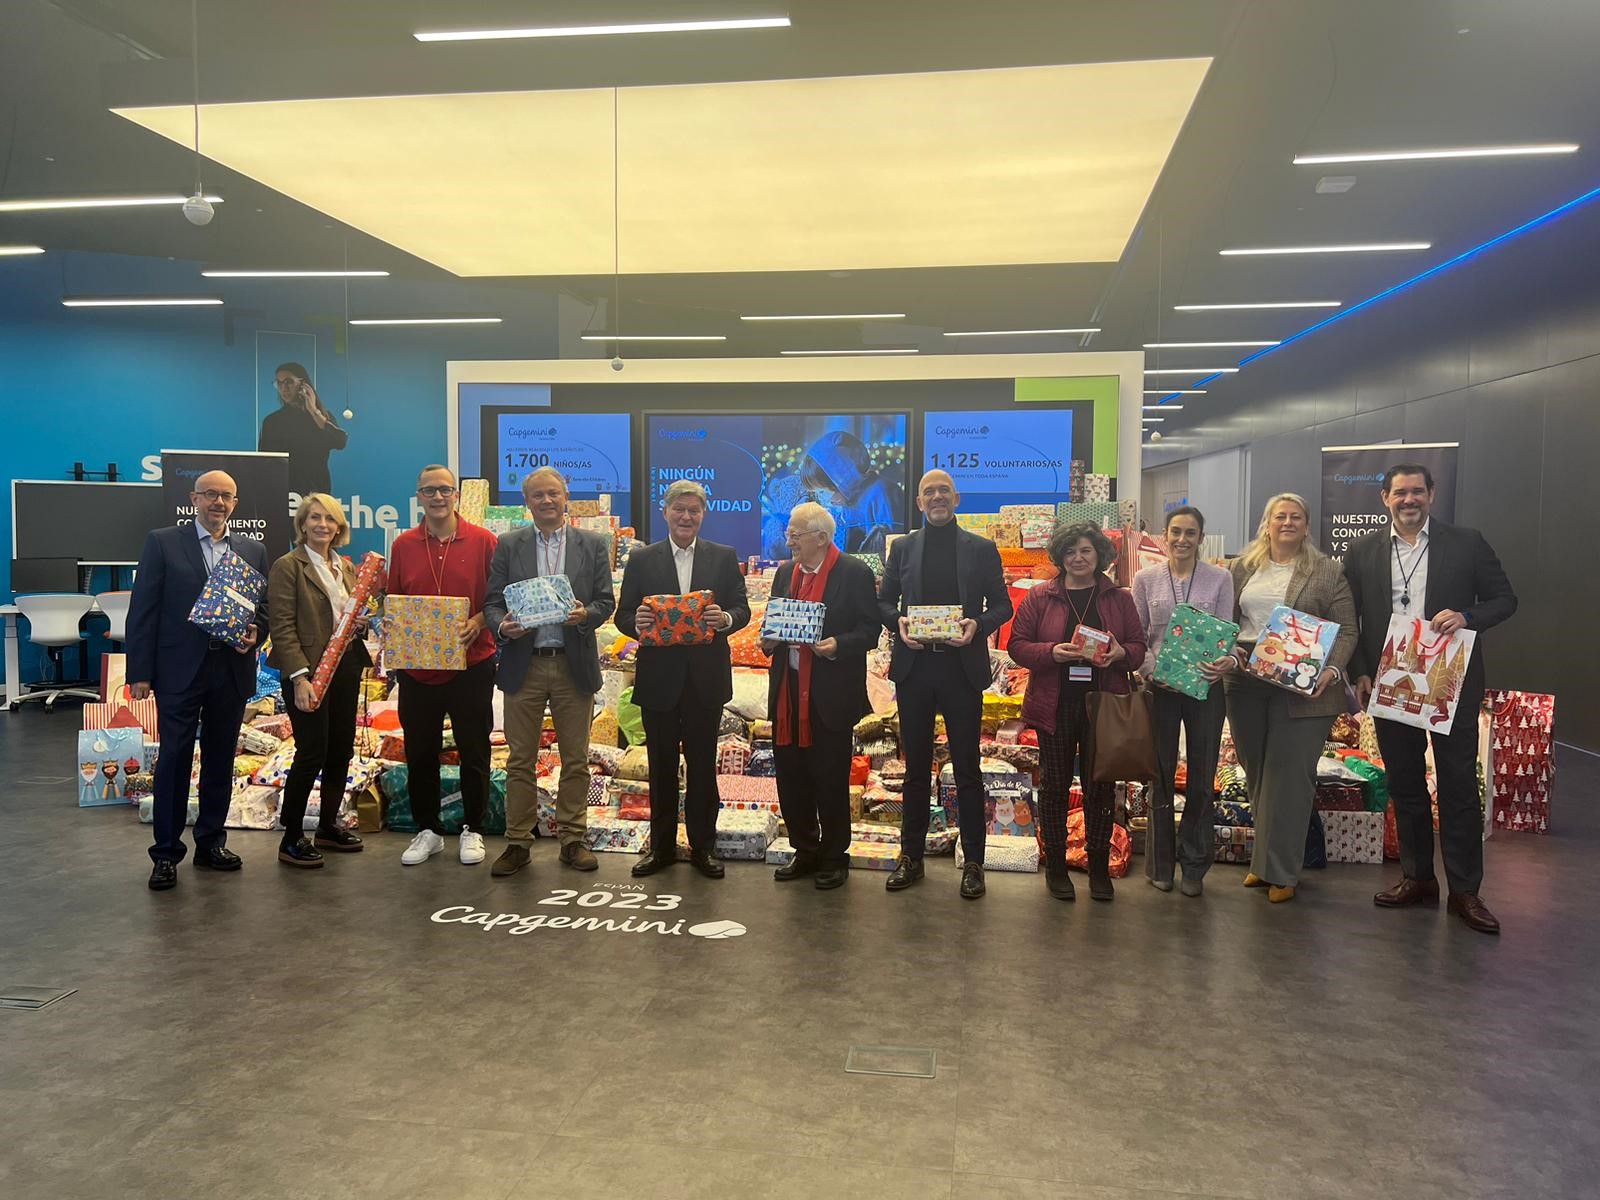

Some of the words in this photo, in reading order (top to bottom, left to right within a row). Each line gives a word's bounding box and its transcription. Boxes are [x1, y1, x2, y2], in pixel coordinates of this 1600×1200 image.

[508, 427, 548, 439] Capgemini
[935, 426, 979, 438] Capgemini
[505, 453, 549, 468] 1.700
[553, 459, 592, 469] NIÑOS/AS
[931, 453, 979, 469] 1.125
[984, 459, 1063, 469] VOLUNTARIOS/AS
[659, 465, 715, 480] NINGÚN
[1334, 473, 1375, 484] Capgemini
[705, 500, 752, 511] VIDAD
[1332, 514, 1388, 524] NUESTRO
[1331, 542, 1338, 551] Y
[537, 889, 682, 910] 2023
[430, 906, 685, 935] Capgemini
